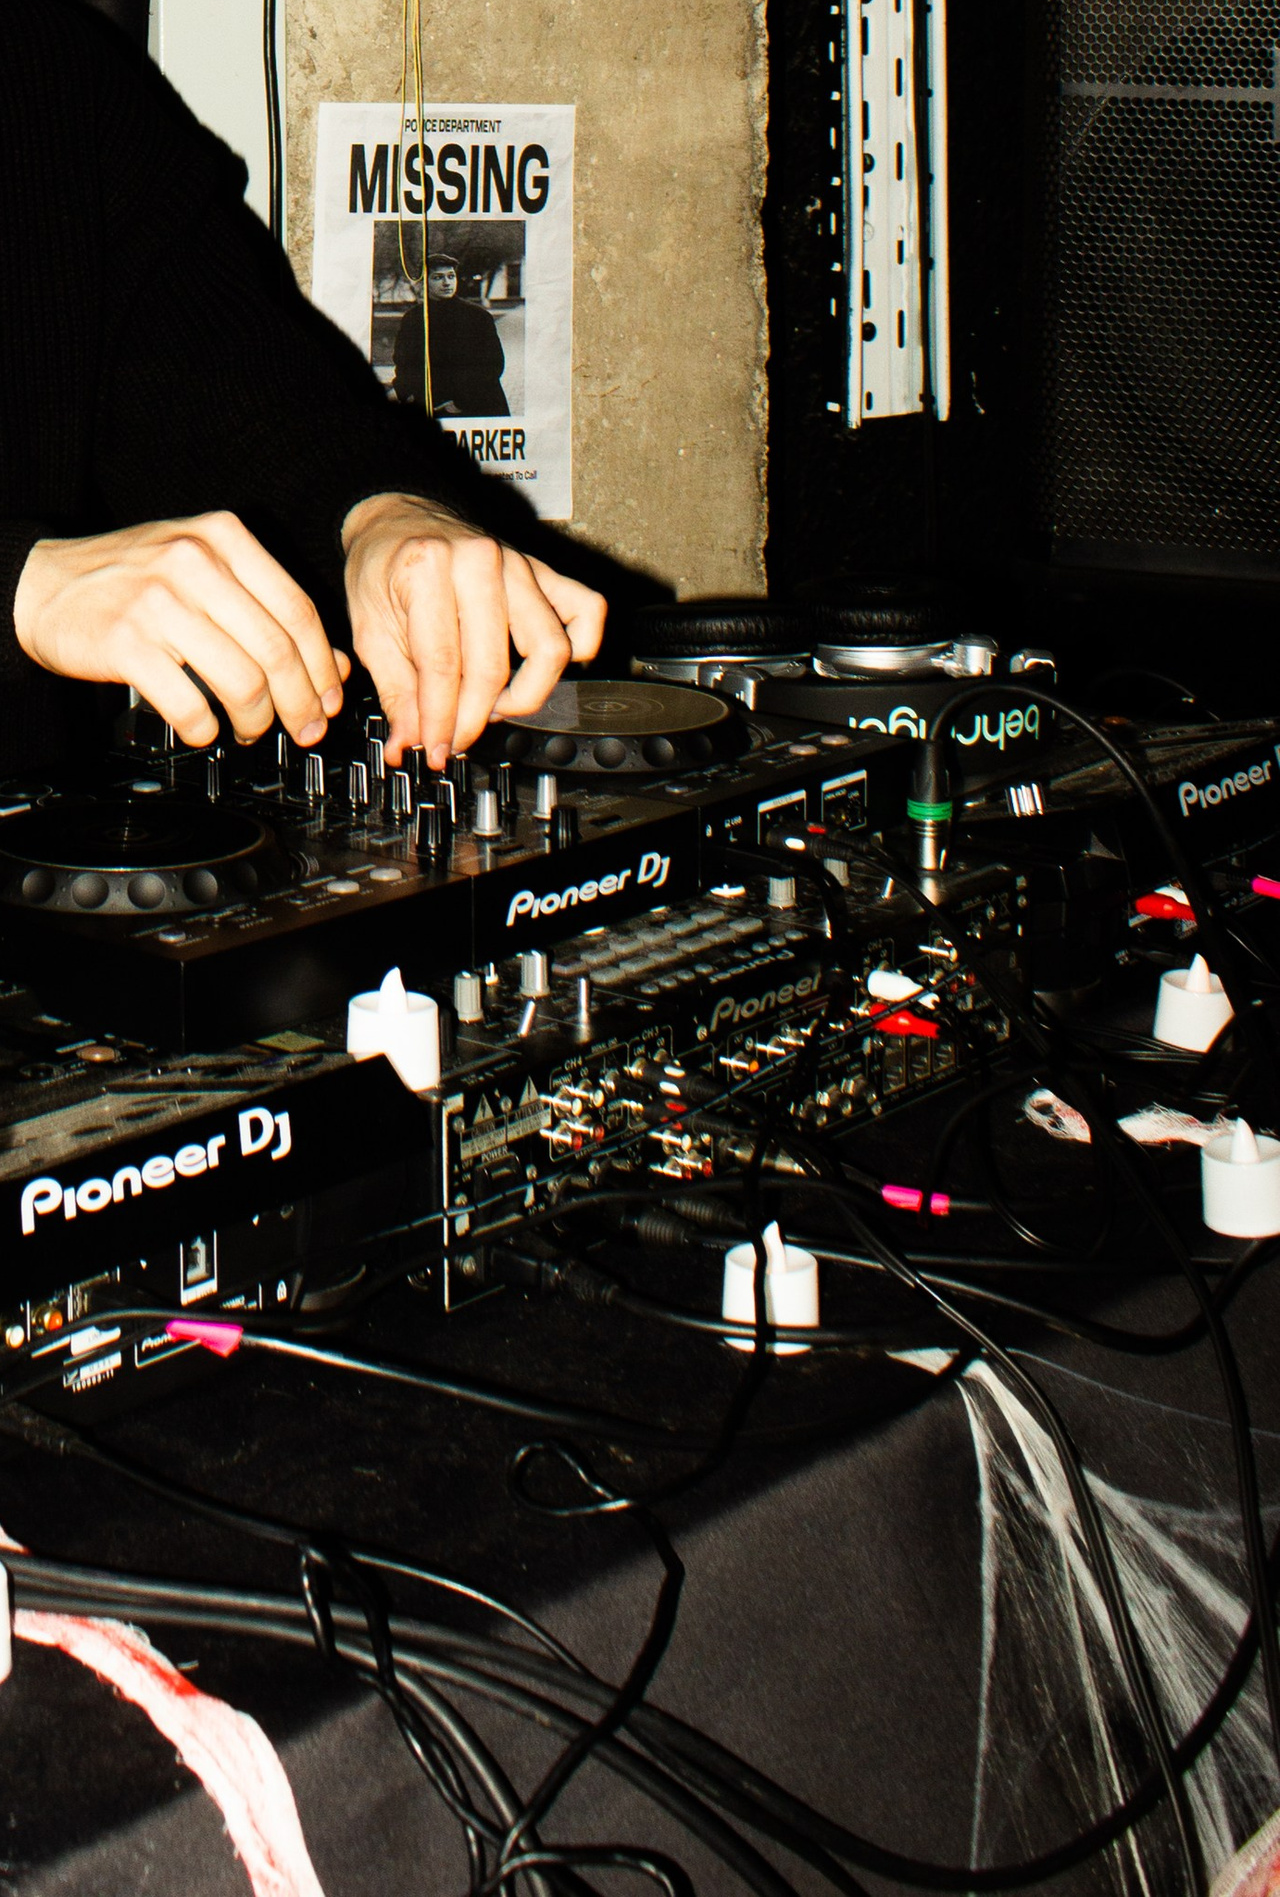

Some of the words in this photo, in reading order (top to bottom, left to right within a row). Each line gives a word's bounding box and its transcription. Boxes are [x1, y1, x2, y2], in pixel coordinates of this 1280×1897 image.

[404, 118, 437, 133] POICE
[438, 118, 502, 134] DEPARTMENT
[348, 142, 550, 215] MISSING
[515, 470, 524, 481] To
[524, 469, 538, 480] Call
[1176, 758, 1273, 818] Pioneer
[506, 868, 632, 927] Pioneer
[710, 970, 823, 1033] Pioneer
[20, 1133, 226, 1235] Pioneer
